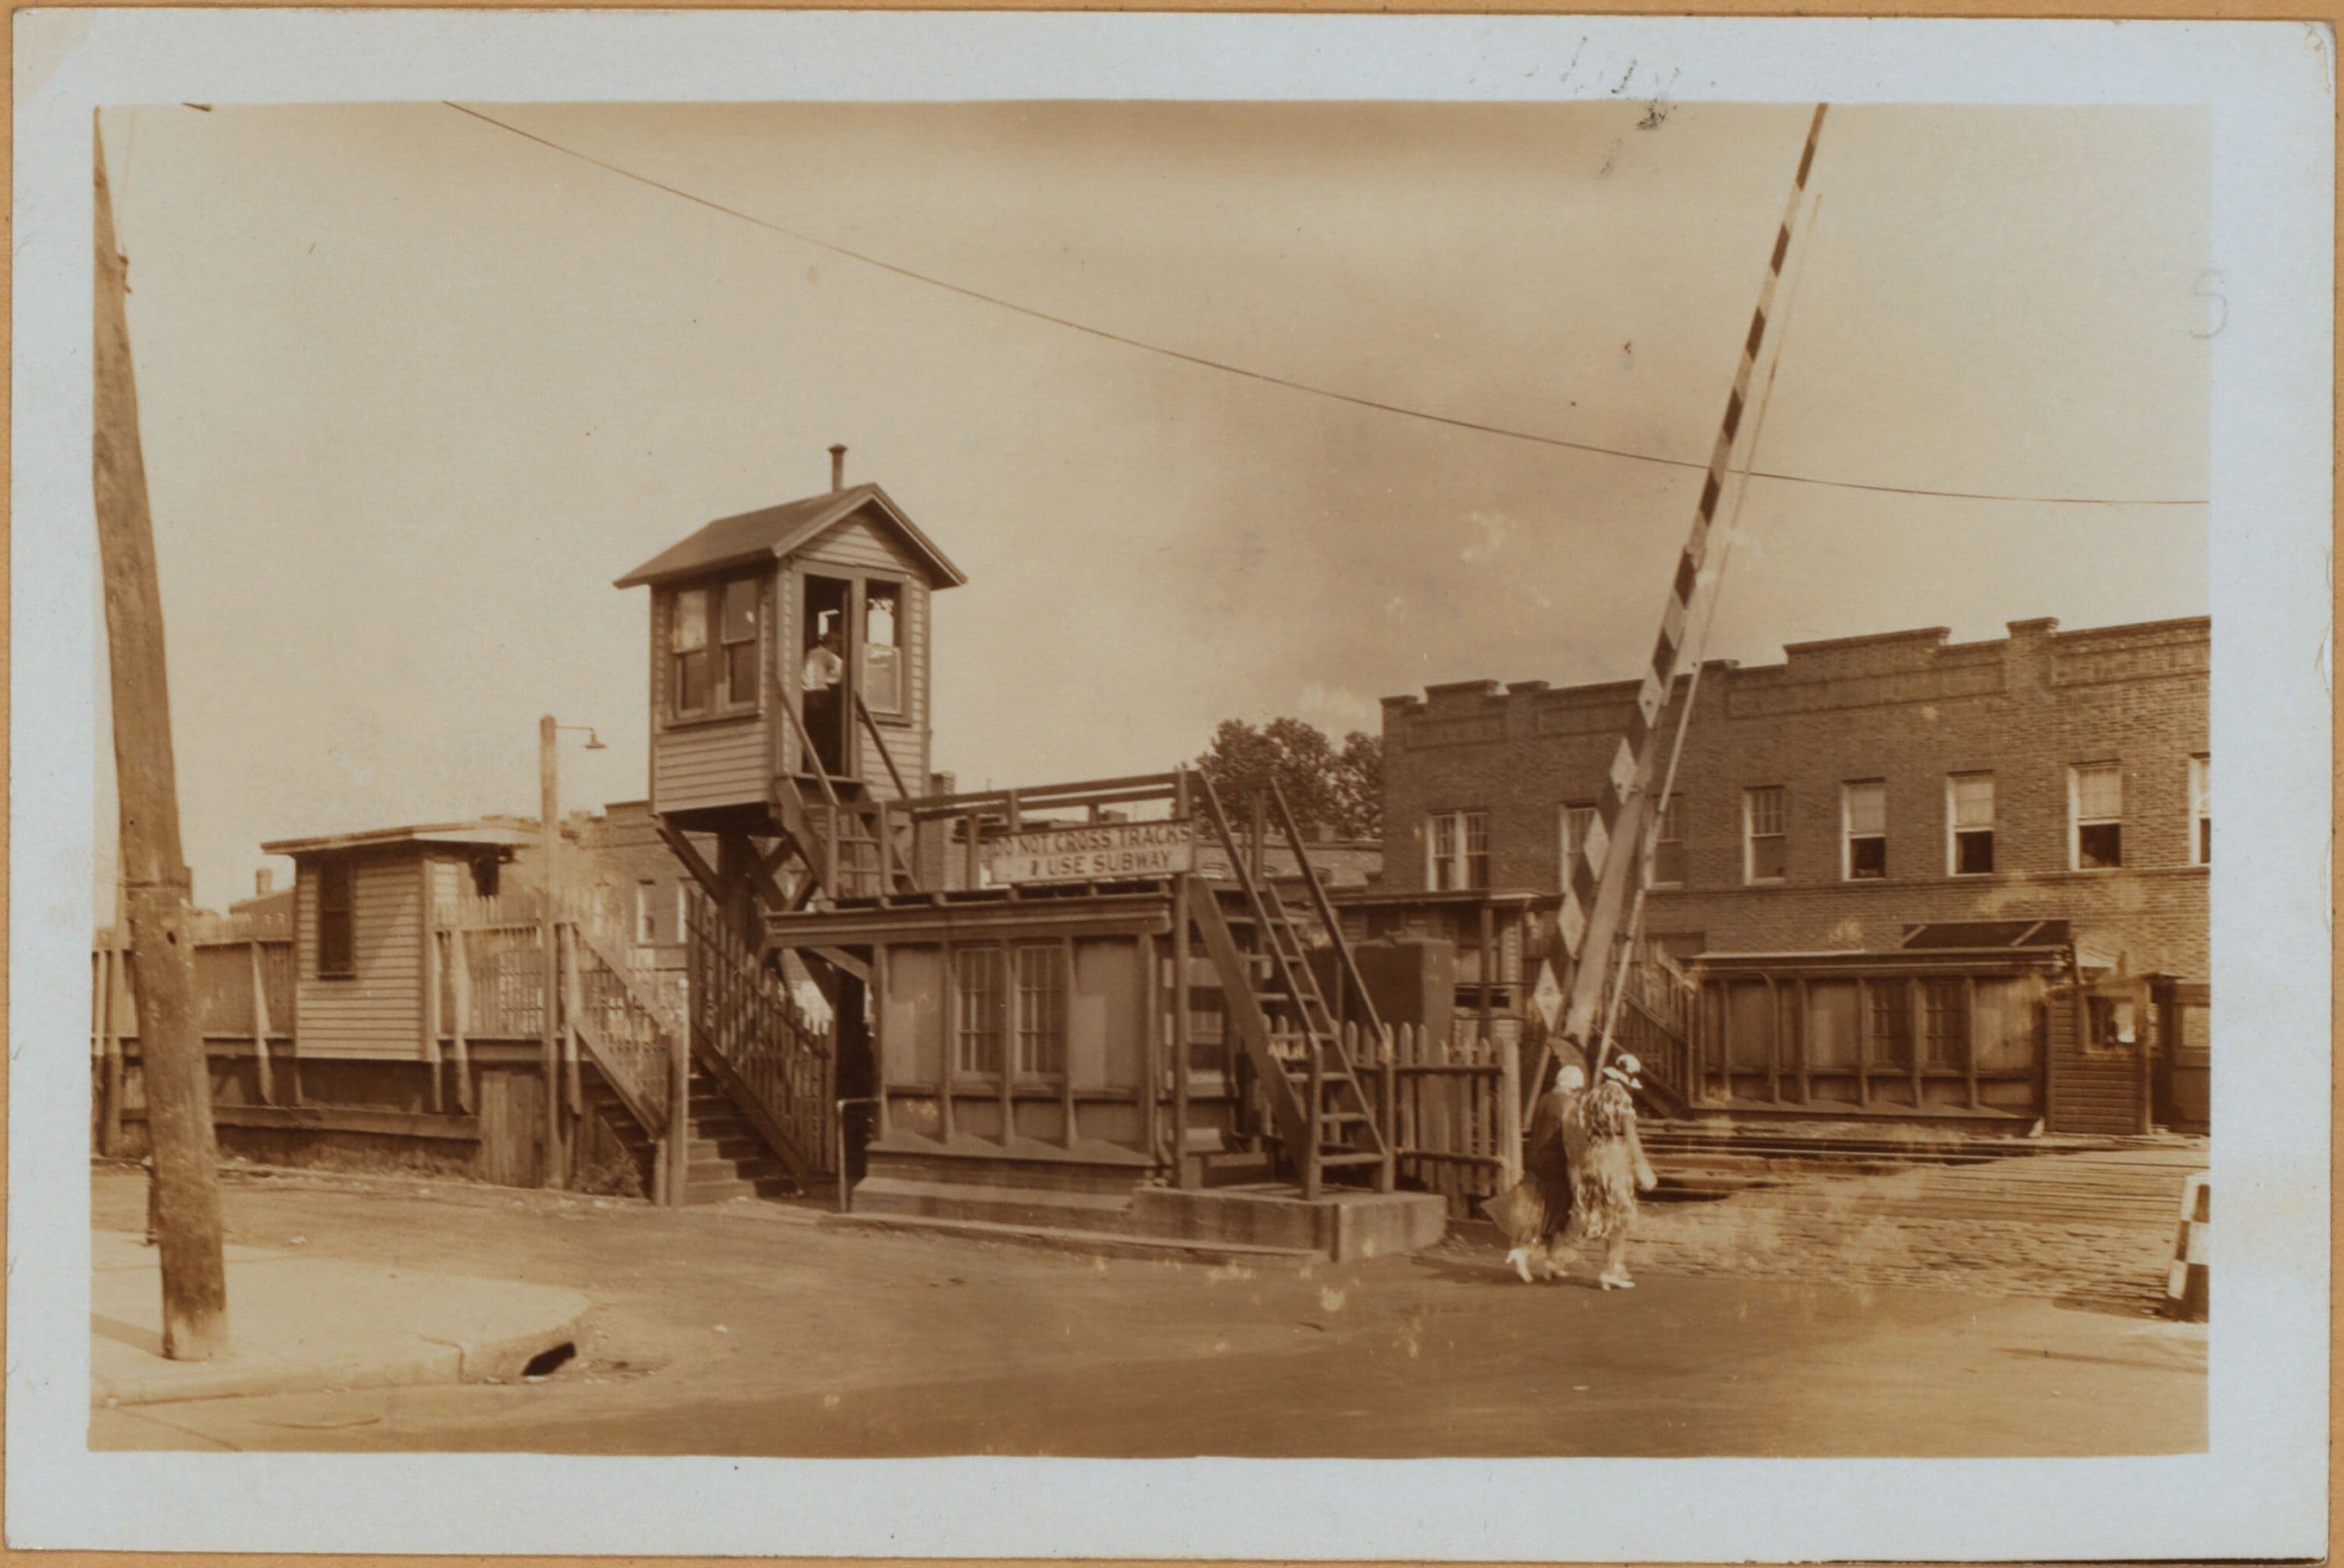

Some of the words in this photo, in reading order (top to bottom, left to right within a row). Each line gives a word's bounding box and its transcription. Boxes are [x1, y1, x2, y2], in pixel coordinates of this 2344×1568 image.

[1018, 832, 1051, 855] NOT
[1054, 829, 1111, 853] CROSS
[1116, 823, 1191, 848] TRACKS
[1047, 855, 1086, 875] USE
[1093, 848, 1169, 872] SUBWAY
